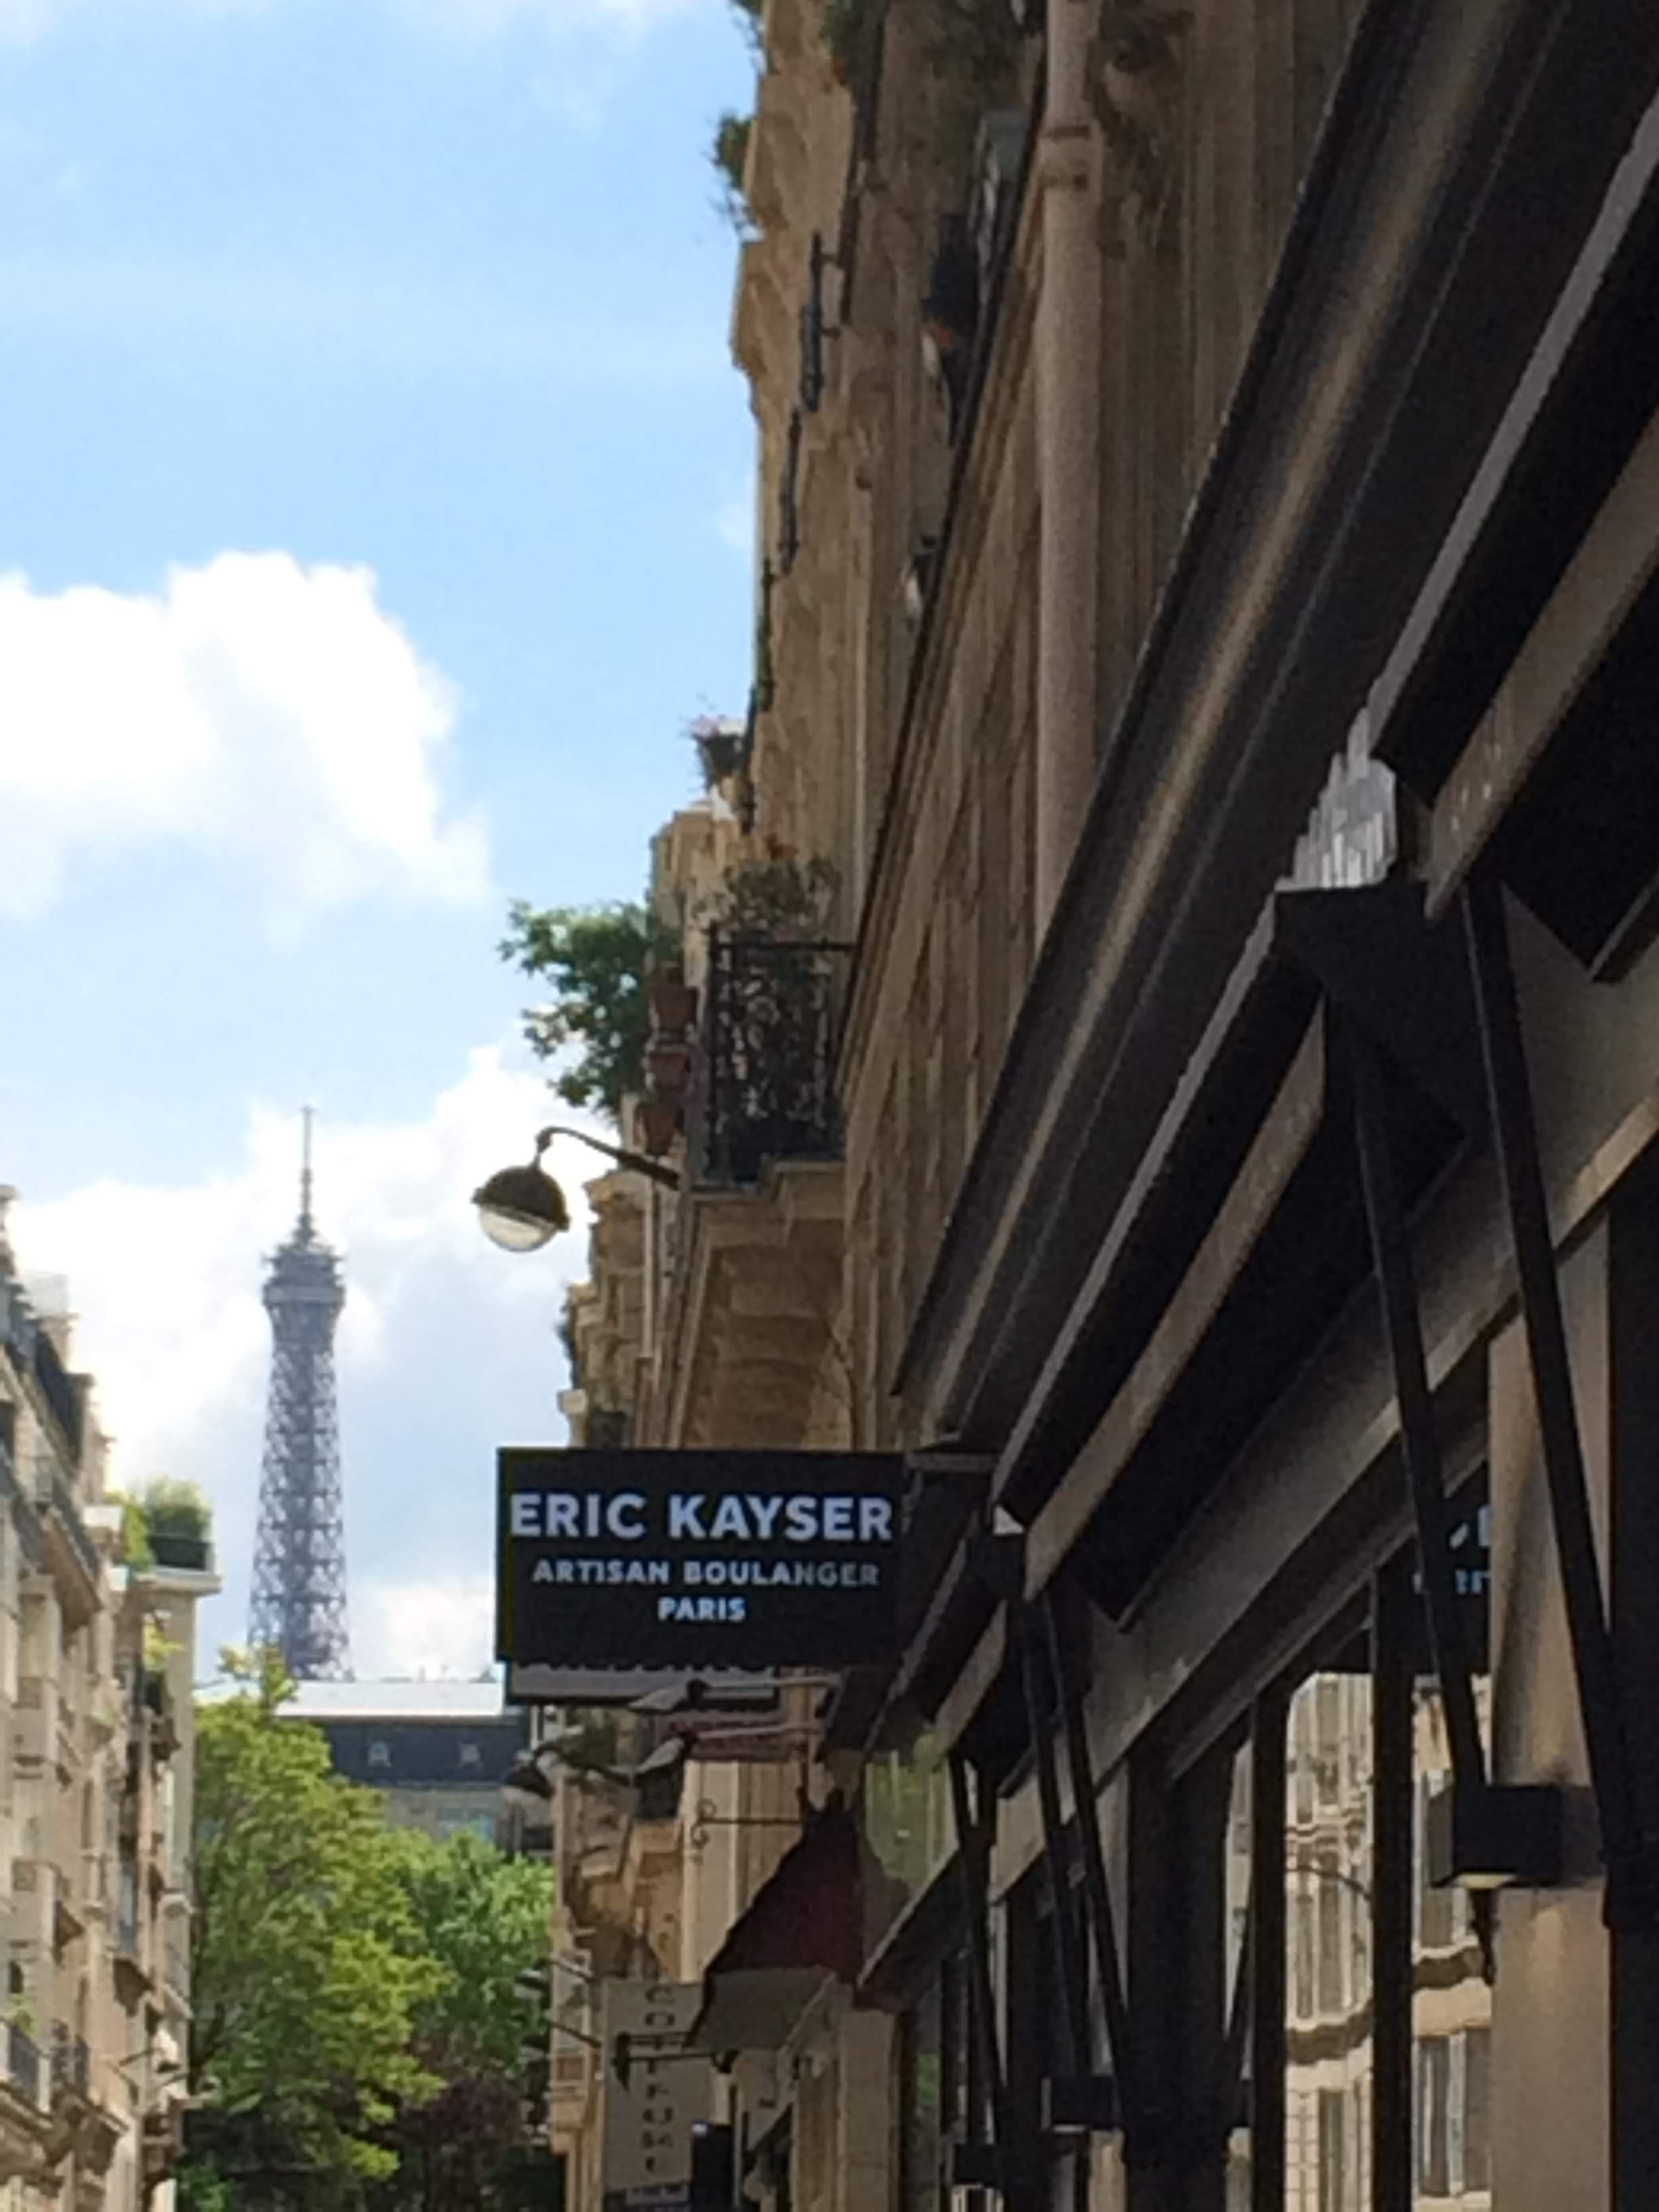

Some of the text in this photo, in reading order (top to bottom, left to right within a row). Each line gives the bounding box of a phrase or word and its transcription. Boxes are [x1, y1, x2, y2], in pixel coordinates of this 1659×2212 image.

[510, 1493, 892, 1540] ERIC KAYSER
[533, 1559, 878, 1586] ARTISAN BOULANGER
[657, 1597, 745, 1621] PARIS
